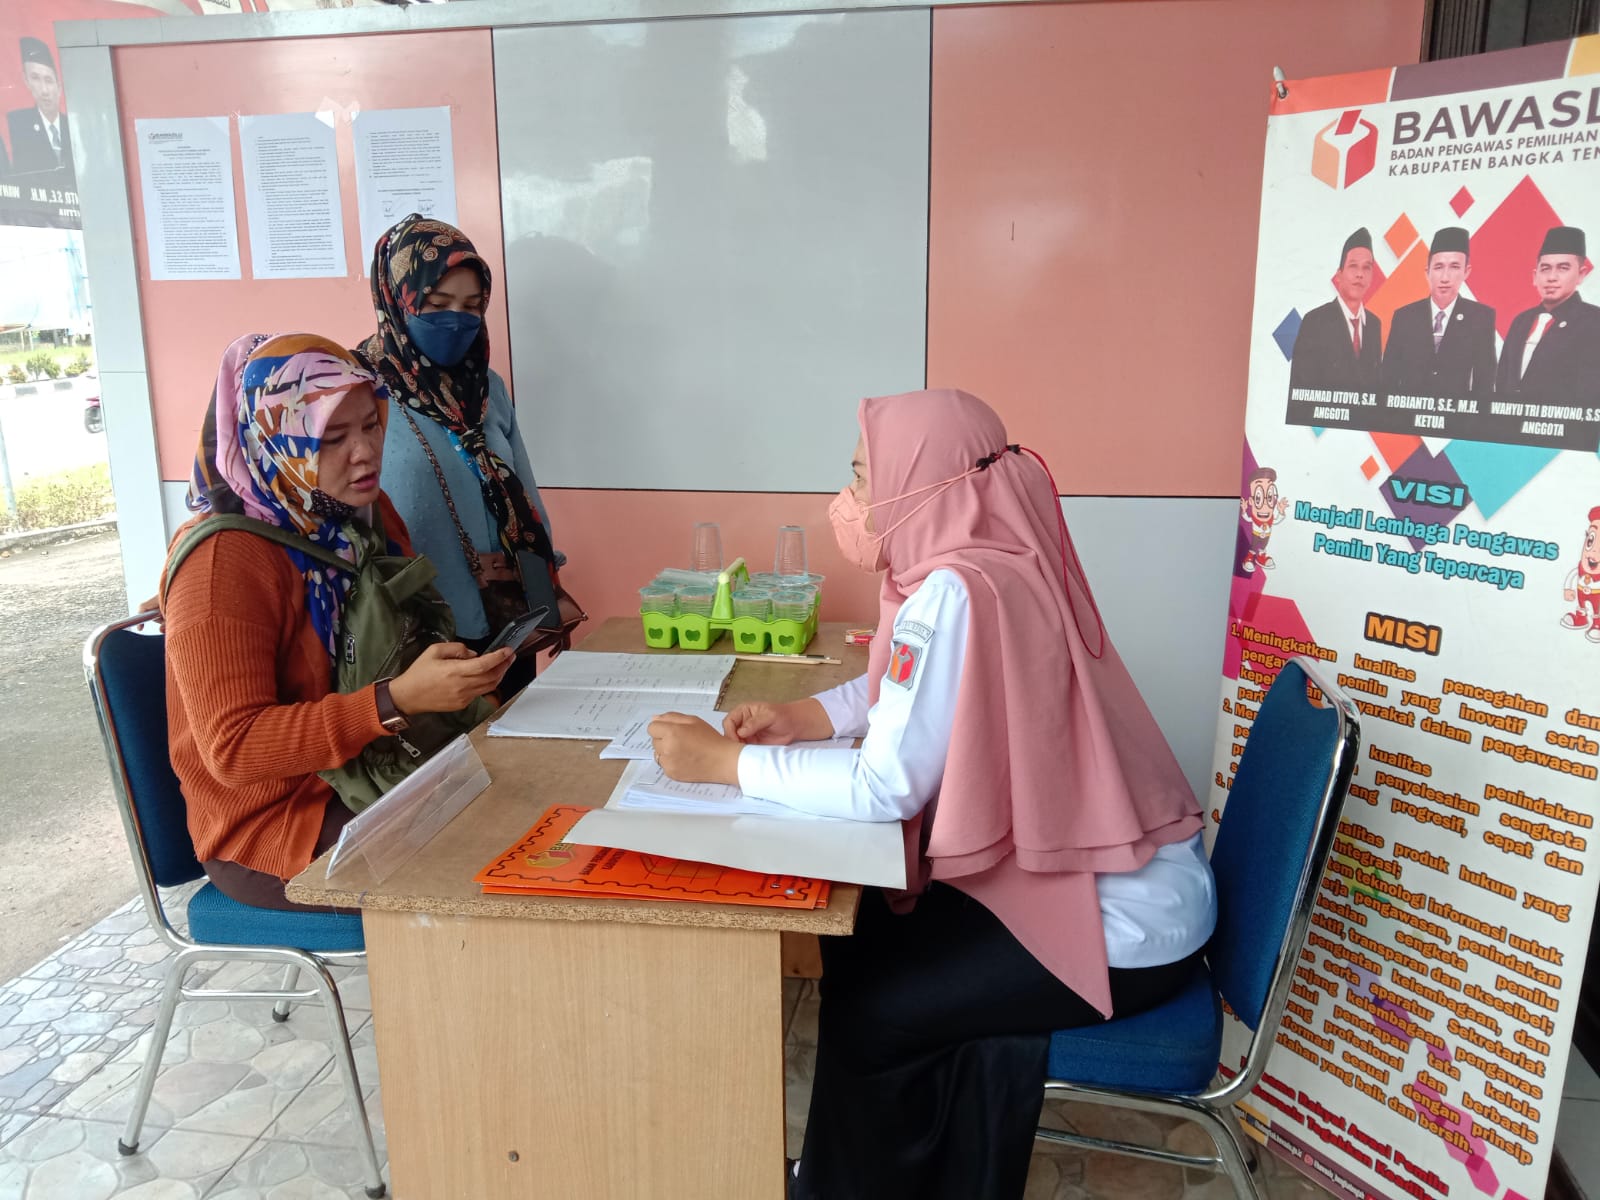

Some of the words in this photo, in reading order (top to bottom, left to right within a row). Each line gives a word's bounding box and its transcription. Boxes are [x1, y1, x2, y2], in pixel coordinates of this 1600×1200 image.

[1389, 157, 1482, 176] KABUPATEN
[1488, 150, 1563, 169] BANGKA
[1390, 147, 1434, 160] BADAN
[1438, 138, 1513, 157] PENGAWAS
[1517, 129, 1598, 149] PEMILIHAN
[1292, 388, 1332, 403] MUHAMAD
[1332, 391, 1361, 406] UTOYO,
[1361, 393, 1377, 406] S.H.
[1313, 406, 1350, 421] ANGGOTA
[1386, 394, 1436, 412] ROBIANTO,
[1437, 398, 1456, 413] S.E.,
[1457, 400, 1479, 414] M.H.
[1414, 415, 1445, 430] KETUA
[1491, 401, 1523, 417] WAHYU
[1524, 404, 1540, 418] TRI
[1540, 405, 1584, 422] BUWONO,
[1521, 421, 1564, 437] ANGGOTA
[1295, 501, 1363, 529] Menjadi
[1365, 511, 1450, 545] Lembaga
[1453, 524, 1560, 561] Pengawas
[1389, 478, 1467, 508] VISI
[1313, 532, 1373, 561] Pemilu
[1376, 542, 1422, 574] Yang
[1424, 551, 1525, 590] Tepercaya
[1365, 613, 1441, 654] MISI
[1231, 623, 1240, 637] 1.
[1242, 626, 1338, 662] Meningkatkan
[1354, 653, 1416, 683] kualitas
[1442, 678, 1548, 718] pencegahan
[1565, 708, 1600, 731] dan
[1242, 649, 1285, 669] penga
[1337, 673, 1388, 698] pemilu
[1401, 690, 1442, 715] yang
[1459, 703, 1527, 735] inovatif
[1545, 730, 1599, 757] serta
[1223, 698, 1232, 714] 2.
[1369, 744, 1432, 777] kualitas
[1484, 784, 1593, 829] penindakan
[1354, 699, 1415, 728] yarakat
[1420, 717, 1472, 744] dalam
[1481, 736, 1598, 780] pengawasan
[1349, 784, 1379, 806] ang
[1391, 798, 1468, 838] progresif,
[1483, 830, 1534, 859] cepat
[1544, 850, 1584, 875] dan
[1375, 771, 1480, 816] penyelesaian
[1499, 813, 1587, 852] sengketa
[1332, 837, 1402, 880] integrasi;
[1393, 842, 1449, 874] produk
[1459, 864, 1517, 901] hukum
[1522, 891, 1572, 922] yang
[1316, 892, 1368, 927] lesaian
[1395, 930, 1468, 973] sengketa
[1495, 974, 1560, 1012] pemilu
[1321, 877, 1349, 897] erja
[1354, 890, 1452, 945] pengawasan,
[1458, 935, 1562, 990] penindakan
[1327, 856, 1354, 879] tem
[1355, 868, 1426, 909] teknologi
[1428, 897, 1507, 943] informasi
[1509, 933, 1564, 967] untuk
[1308, 931, 1382, 976] penguatan
[1391, 968, 1502, 1037] kelembagaan,
[1513, 1029, 1550, 1056] dan
[1311, 913, 1347, 940] ektif,
[1348, 927, 1429, 976] transparan
[1430, 966, 1462, 992] dan
[1463, 983, 1555, 1036] aksesibel;
[1291, 980, 1319, 1005] lalui
[1333, 1004, 1410, 1054] penerapan
[1427, 1052, 1461, 1081] tata
[1484, 1080, 1540, 1123] kelola
[1296, 966, 1339, 997] enjang
[1347, 987, 1445, 1050] kelembagaan
[1455, 1046, 1543, 1100] pengawas
[1324, 959, 1360, 986] serta
[1369, 983, 1435, 1022] aparatur
[1447, 1018, 1546, 1078] Sekretariat
[1287, 1000, 1313, 1024] ang
[1323, 1019, 1404, 1072] profesional
[1417, 1071, 1447, 1096] dan
[1462, 1091, 1539, 1145] berbasis
[1320, 1057, 1354, 1088] yang
[1354, 1075, 1387, 1106] baik
[1388, 1096, 1417, 1123] dan
[1418, 1112, 1474, 1156] bersih.
[1342, 1051, 1390, 1085] sesuai
[1402, 1083, 1460, 1125] dengan
[1471, 1122, 1533, 1166] prinsip
